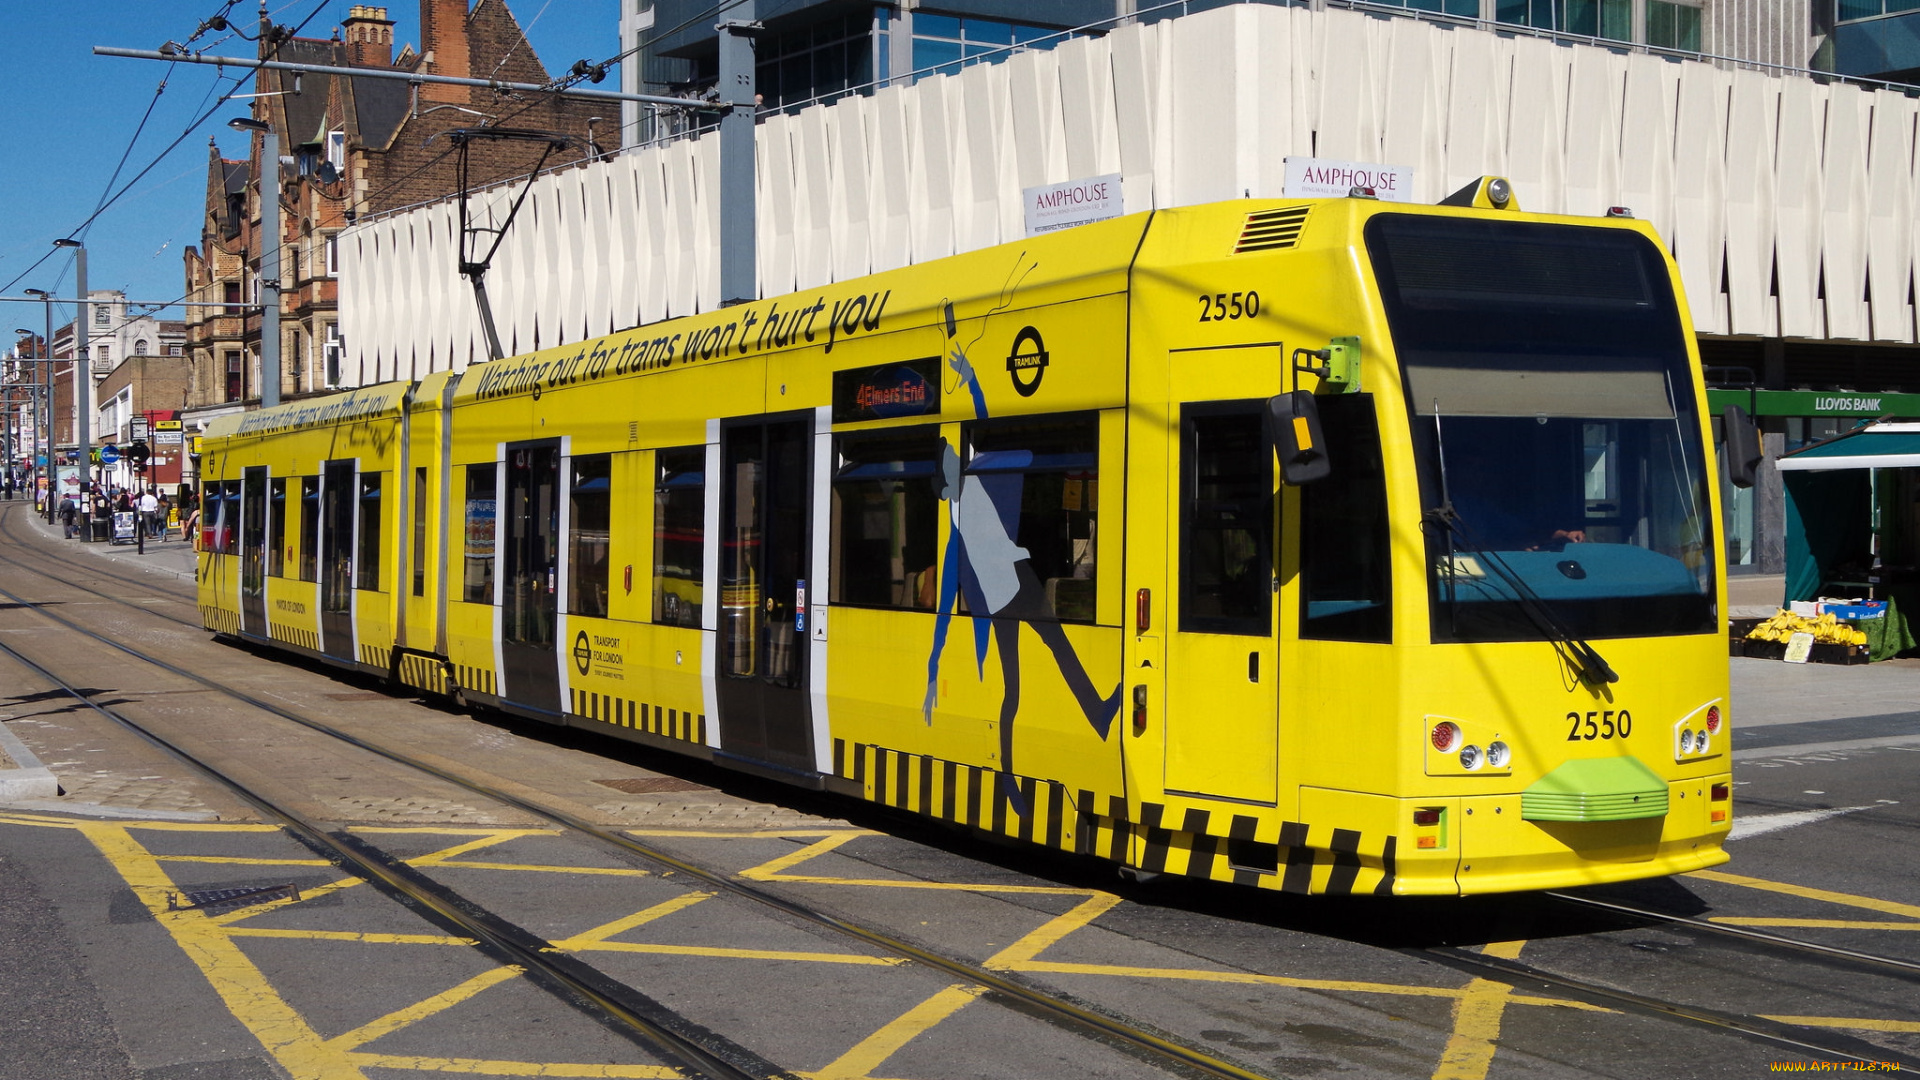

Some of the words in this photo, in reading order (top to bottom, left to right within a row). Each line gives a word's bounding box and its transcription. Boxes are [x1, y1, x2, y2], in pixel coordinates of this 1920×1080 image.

[1302, 166, 1396, 190] AMPHOUSE
[1036, 183, 1108, 209] AMPHOUSE
[1198, 290, 1259, 321] 2550
[475, 356, 551, 401] Watching
[547, 353, 585, 388] out
[583, 340, 617, 380] for
[615, 334, 681, 374] trams
[686, 309, 758, 363] won't
[756, 302, 826, 351] hurt
[825, 290, 891, 354] you
[1014, 355, 1041, 367] TRAMLINK
[903, 379, 925, 405] End
[1815, 397, 1852, 410] LLOYDS
[1853, 398, 1881, 411] BANK
[594, 635, 620, 648] TRANSPORT
[594, 651, 602, 661] FOR
[603, 653, 623, 664] LONDON
[1566, 710, 1632, 741] 2550
